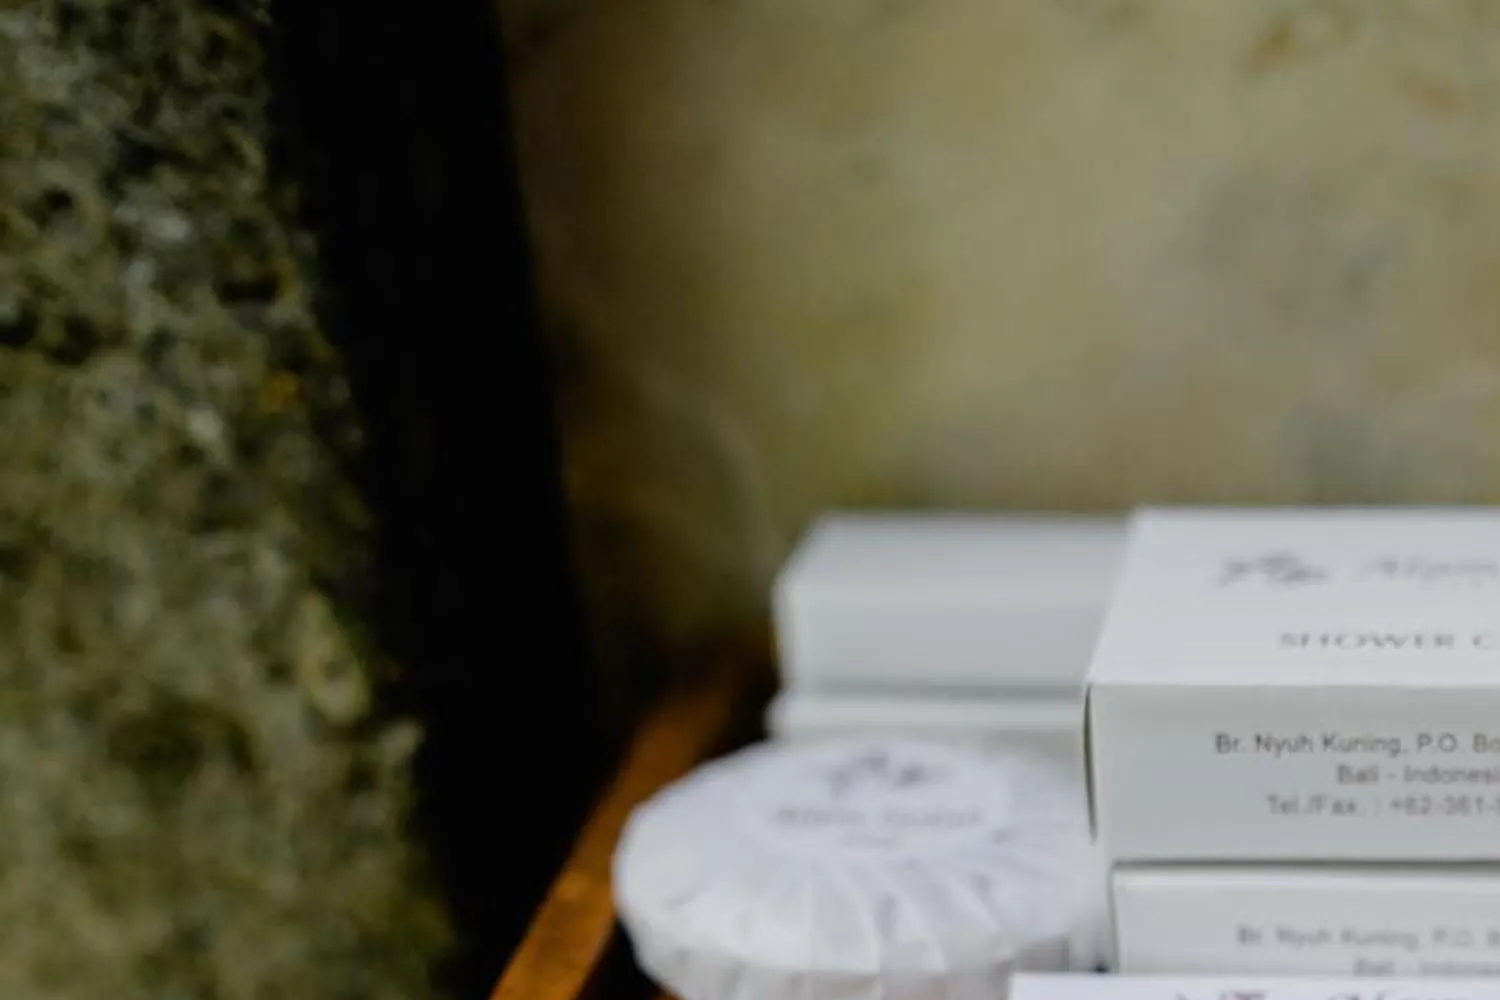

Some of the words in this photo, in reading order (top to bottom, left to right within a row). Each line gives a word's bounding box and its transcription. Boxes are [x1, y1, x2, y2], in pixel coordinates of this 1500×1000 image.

[1278, 631, 1456, 651] SHOWER
[1213, 731, 1247, 754] Br.
[1254, 731, 1314, 759] Nyuh
[1336, 763, 1380, 785] Bali
